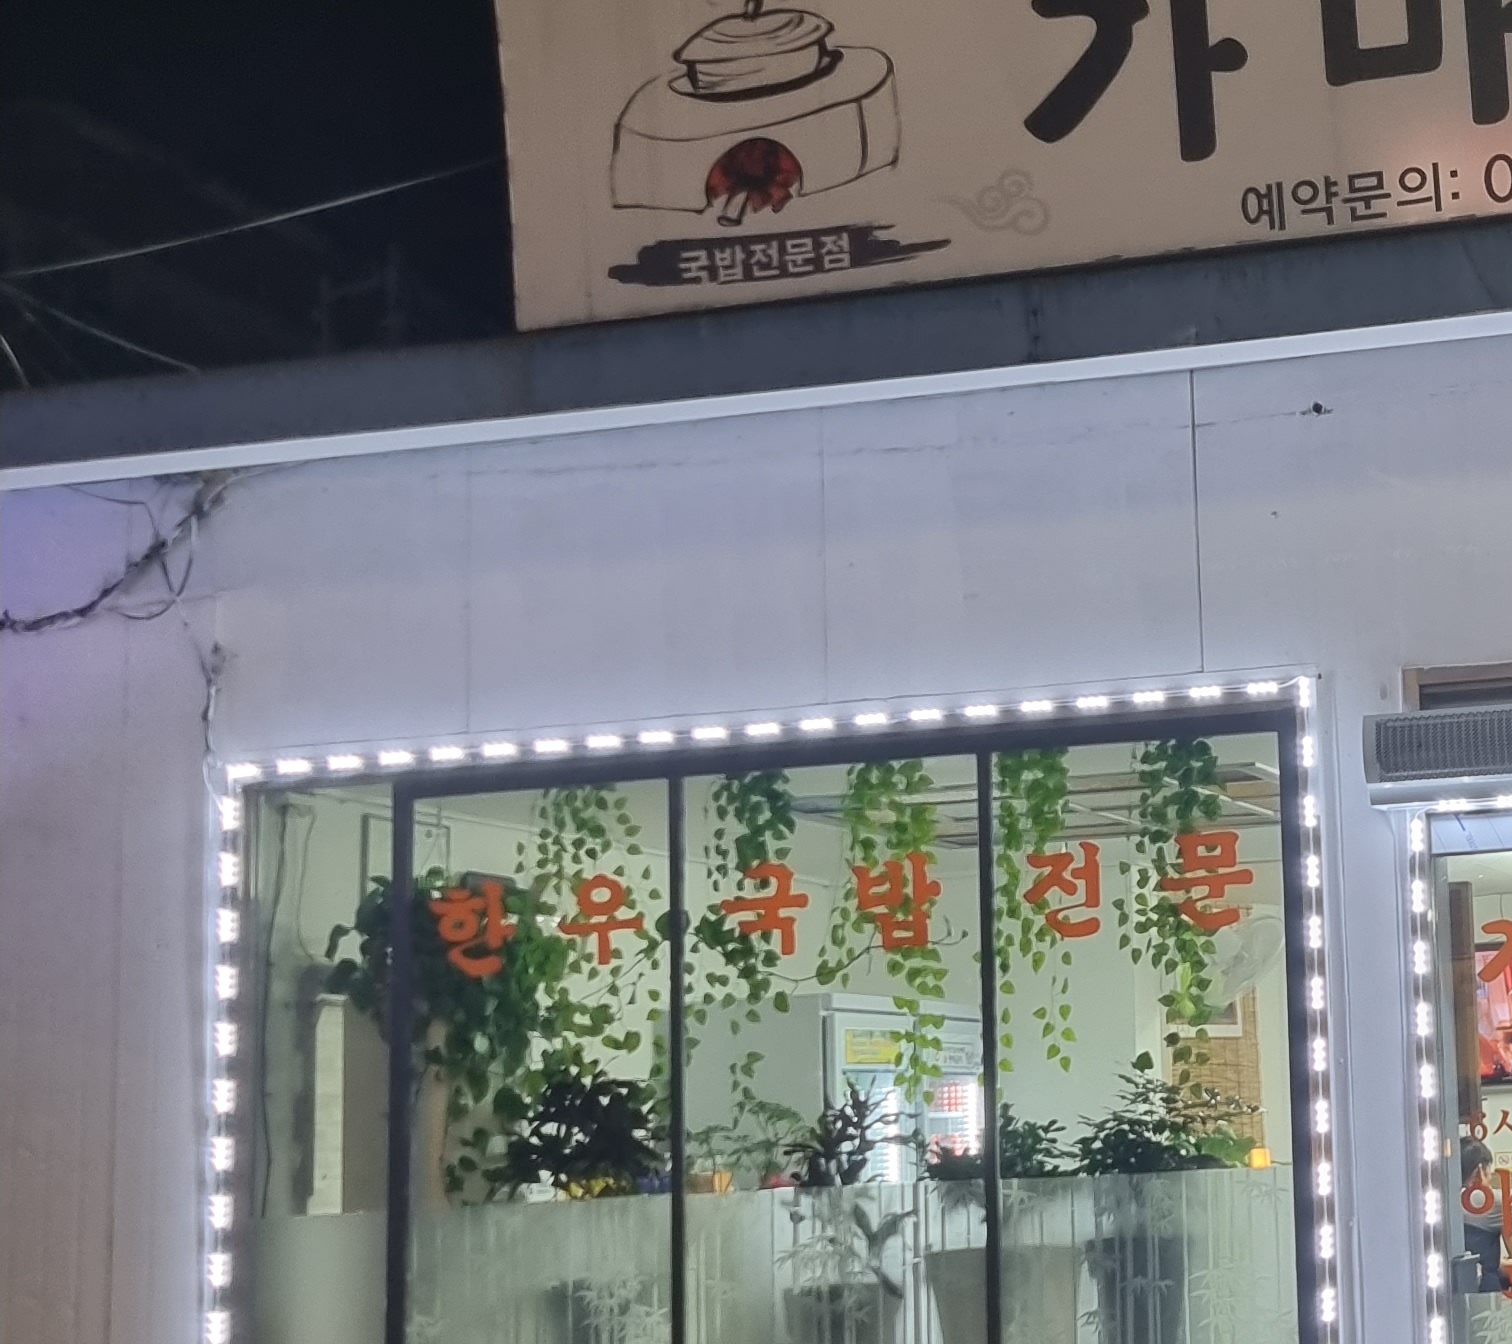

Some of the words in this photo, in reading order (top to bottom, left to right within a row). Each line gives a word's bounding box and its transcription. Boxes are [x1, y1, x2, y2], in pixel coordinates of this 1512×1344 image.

[1241, 161, 1461, 231] 예약문의:
[678, 231, 852, 285] 국밥전문점
[428, 873, 644, 979] 한우
[719, 850, 943, 956] 국밥
[1023, 830, 1254, 939] 전문
